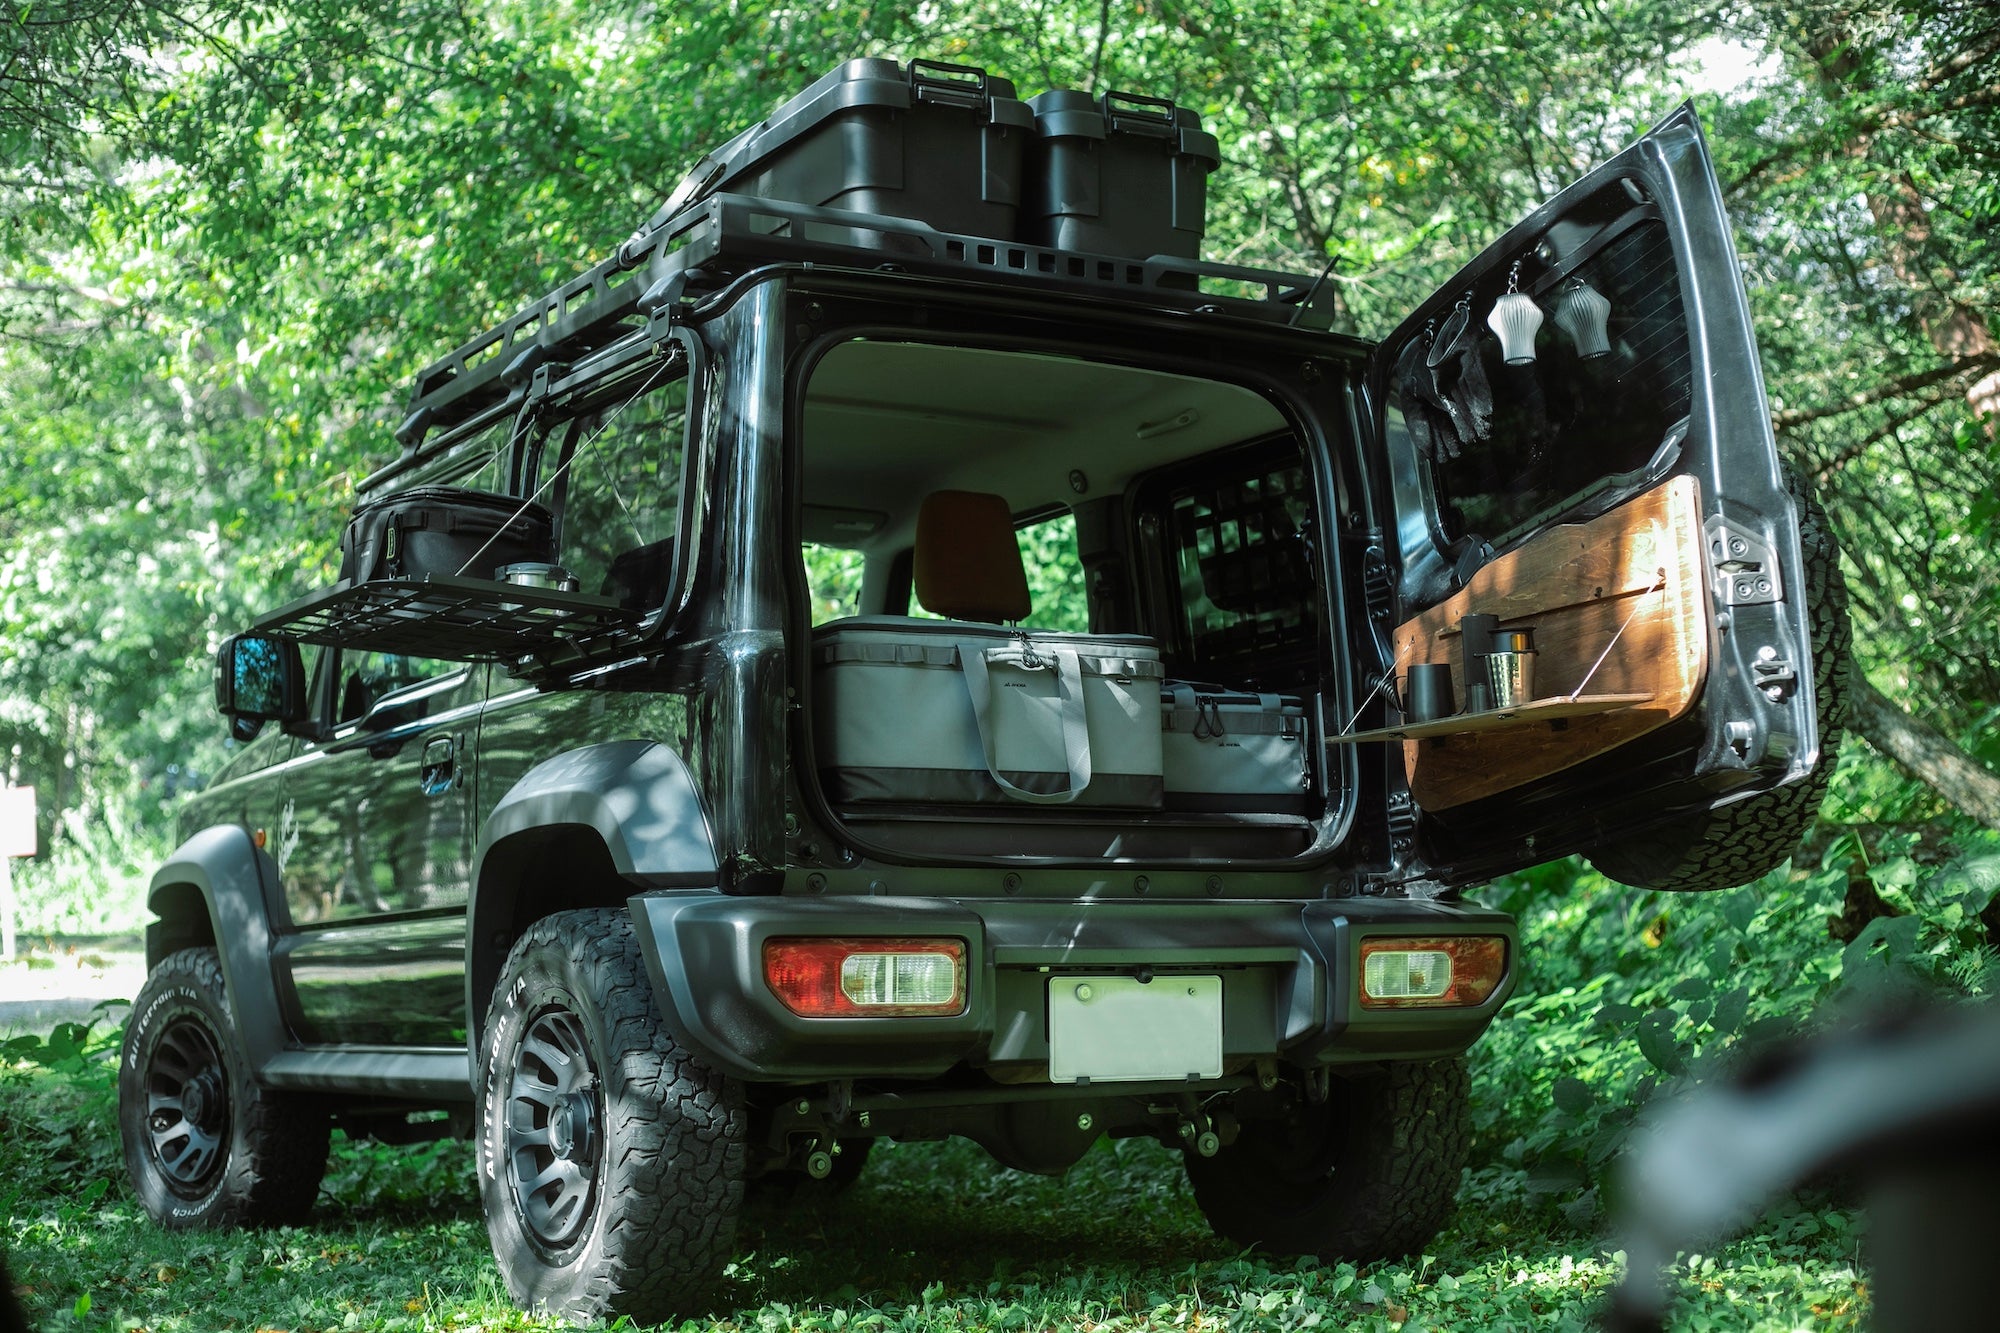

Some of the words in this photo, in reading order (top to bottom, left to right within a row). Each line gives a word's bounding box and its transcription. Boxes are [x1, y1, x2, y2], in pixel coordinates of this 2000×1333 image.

[129, 988, 175, 1070] All-Terrain
[179, 985, 198, 1000] T/A
[484, 1014, 508, 1181] All-Terrain
[506, 975, 527, 1009] T/A
